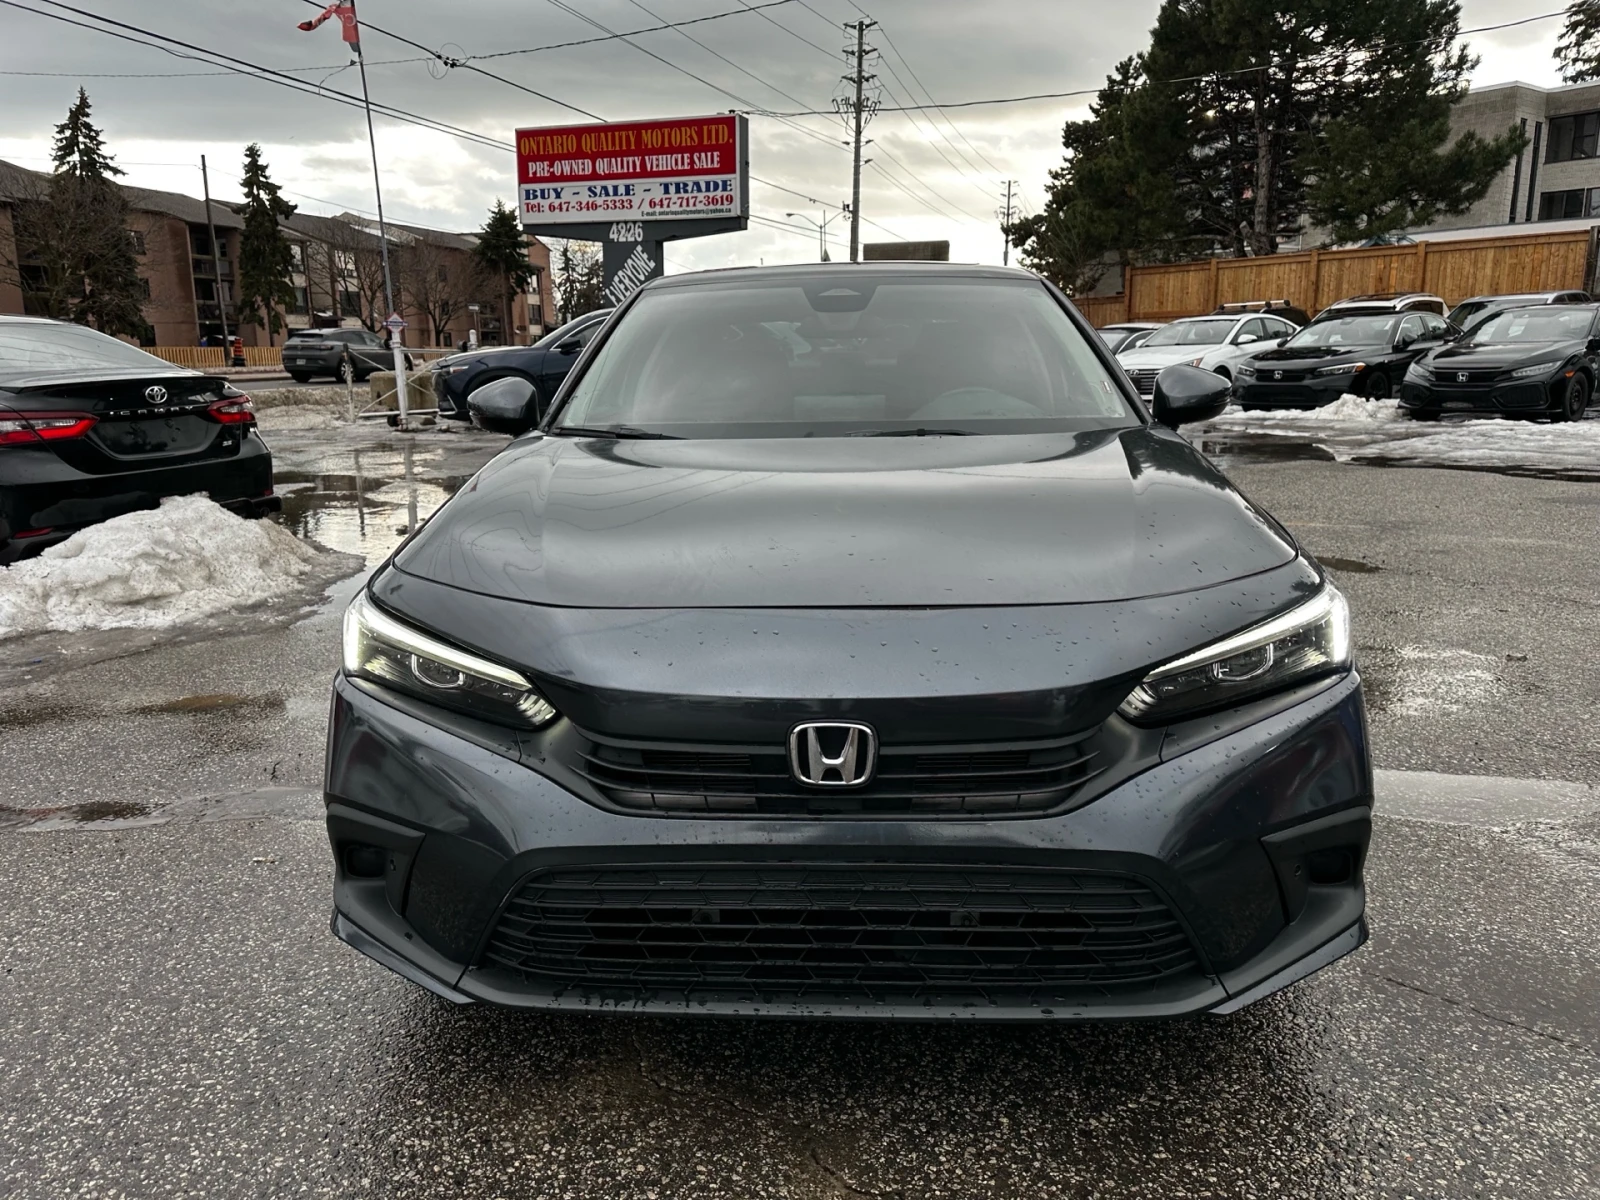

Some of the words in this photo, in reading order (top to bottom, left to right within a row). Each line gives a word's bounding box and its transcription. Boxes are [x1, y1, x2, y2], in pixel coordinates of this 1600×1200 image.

[520, 134, 577, 156] ONTARIO
[581, 131, 637, 154] QUALITY
[641, 126, 698, 149] MOTORS
[702, 124, 733, 145] LTD.
[528, 159, 592, 177] PRE-OWNED
[595, 156, 642, 175] QUALITY
[645, 153, 690, 172] VEHICLE
[693, 151, 720, 169] SALE
[524, 187, 564, 201] BUY
[587, 184, 636, 198] SALE
[660, 180, 733, 195] TRADE
[524, 201, 544, 213] Tel:
[548, 199, 633, 213] 647-346-5333
[649, 194, 734, 209] 647-717-3619
